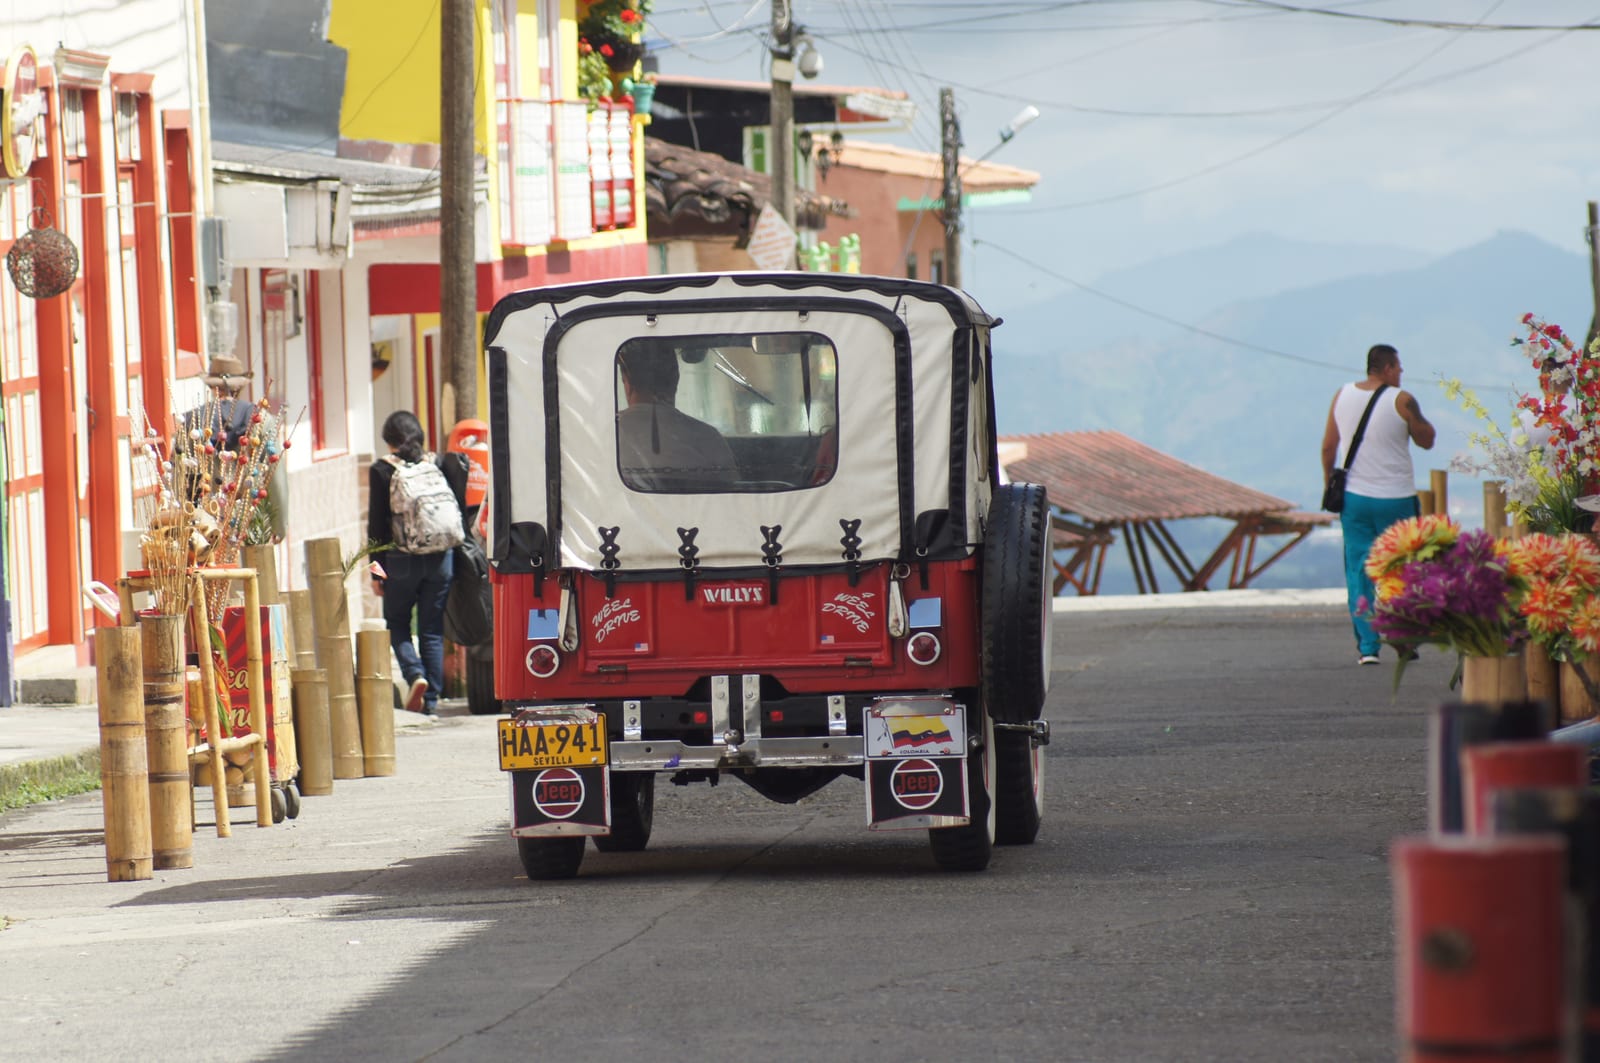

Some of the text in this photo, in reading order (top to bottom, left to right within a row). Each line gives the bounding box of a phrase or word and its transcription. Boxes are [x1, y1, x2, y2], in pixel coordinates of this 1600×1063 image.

[592, 598, 631, 627] WEEL
[821, 602, 870, 633] DRIVE
[595, 609, 641, 644] DRIVE
[533, 755, 573, 766] SEVILLA
[537, 781, 581, 803] Jeep
[895, 772, 940, 795] Jeep
